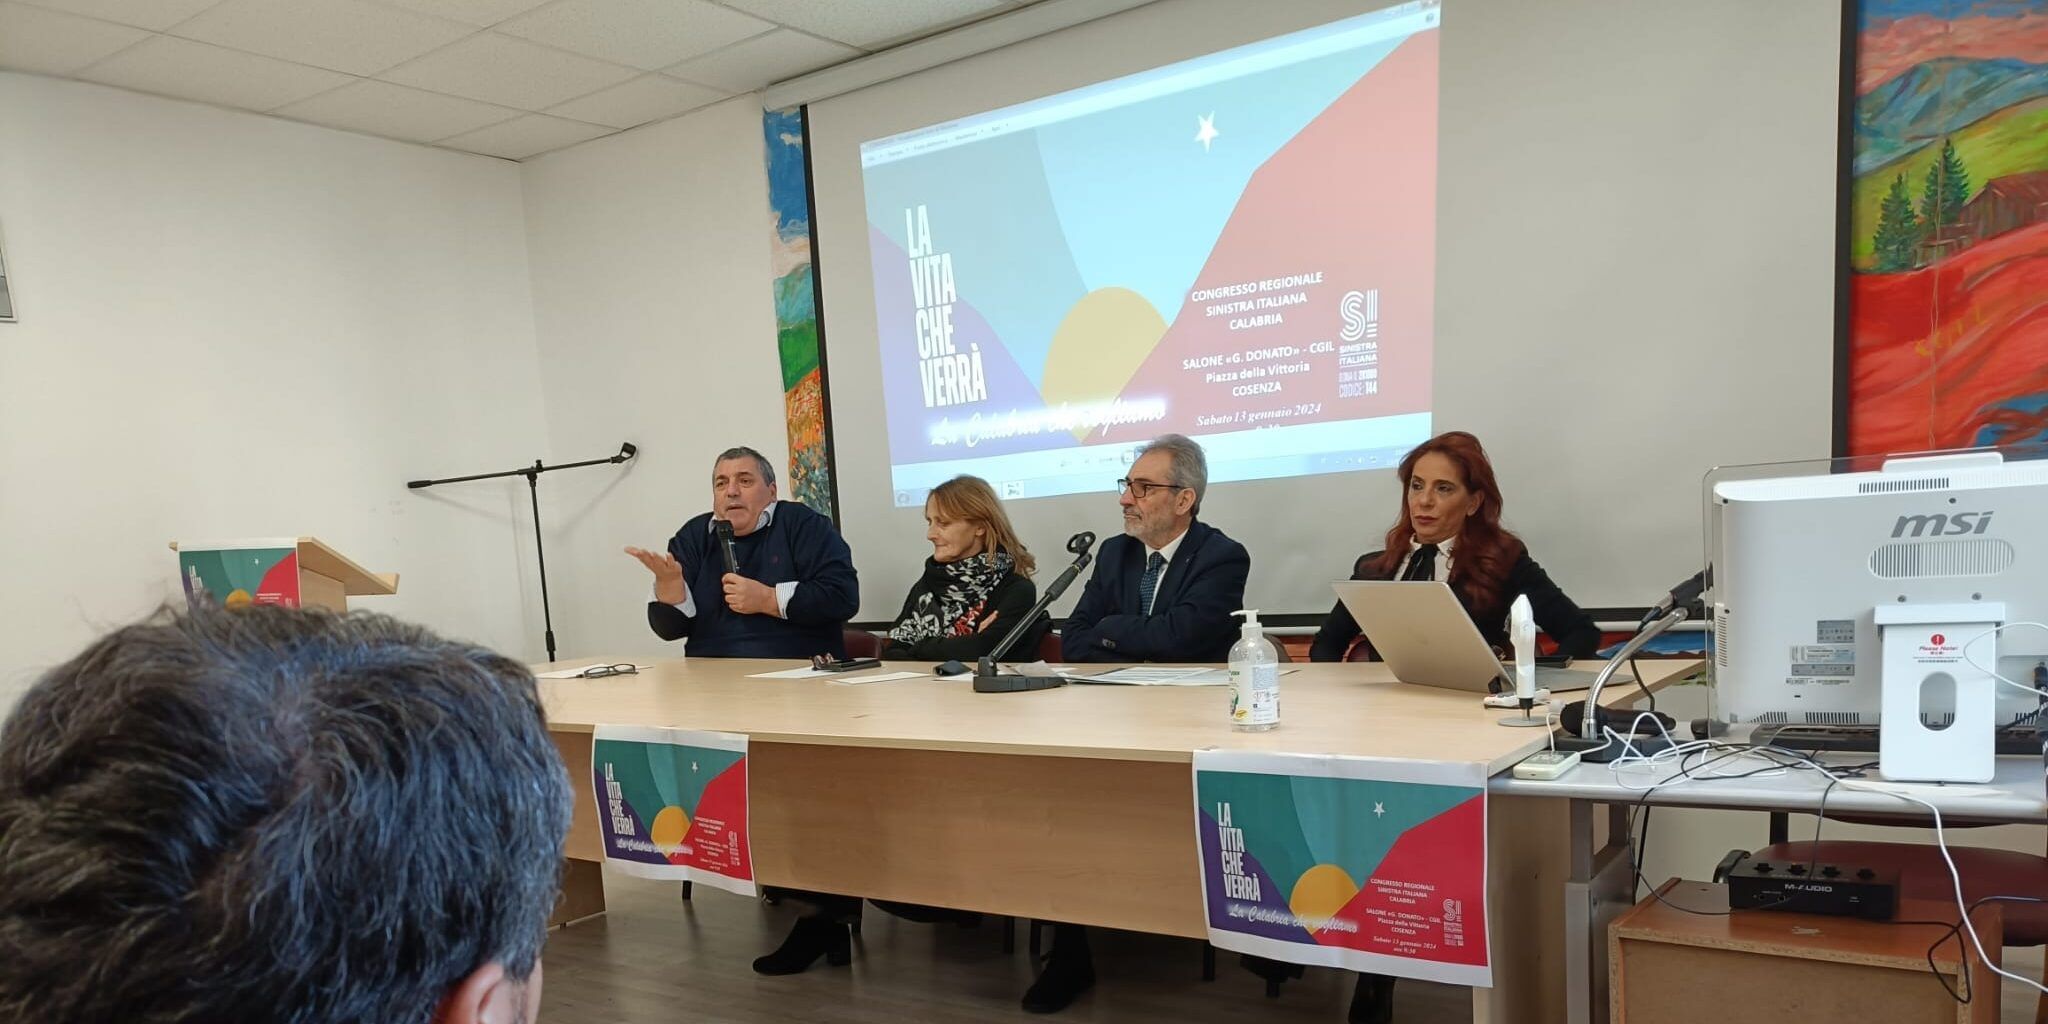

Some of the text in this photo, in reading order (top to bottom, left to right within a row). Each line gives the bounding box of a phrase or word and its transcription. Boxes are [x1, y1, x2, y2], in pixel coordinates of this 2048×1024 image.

[905, 204, 933, 258] LA
[909, 253, 957, 309] VITA
[1192, 271, 1323, 302] CONGRESSO REGIONALE
[1206, 292, 1308, 317] SINISTRA ITALIANA
[914, 304, 956, 360] CHE
[1230, 313, 1283, 330] CALABRIA
[1183, 354, 1224, 370] SALONE
[1246, 346, 1299, 362] DONATO»
[1309, 341, 1335, 354] CGIL
[919, 342, 987, 408] VERRÀ
[1206, 361, 1310, 384] Piazza della Vittoria
[1232, 381, 1282, 397] COSENZA
[1196, 402, 1322, 427] Sabato 13 gennaio 2024
[1891, 511, 1995, 538] msi
[605, 762, 614, 781] LA
[606, 781, 623, 800] VITA
[1217, 802, 1232, 827] LA
[1219, 826, 1245, 852] VITA
[1221, 850, 1245, 875] CHE
[1223, 872, 1261, 902] VERRÀ
[1370, 878, 1435, 891] CONGRESSO REGIONALE
[1402, 890, 1428, 898] ITALIANA
[1785, 884, 1833, 893] M-AUDIO
[1366, 907, 1386, 916] SALONE
[1389, 896, 1416, 904] CALABRIA
[1229, 904, 1244, 918] La
[1248, 906, 1289, 926] Calabria
[1392, 927, 1416, 935] COSENZA
